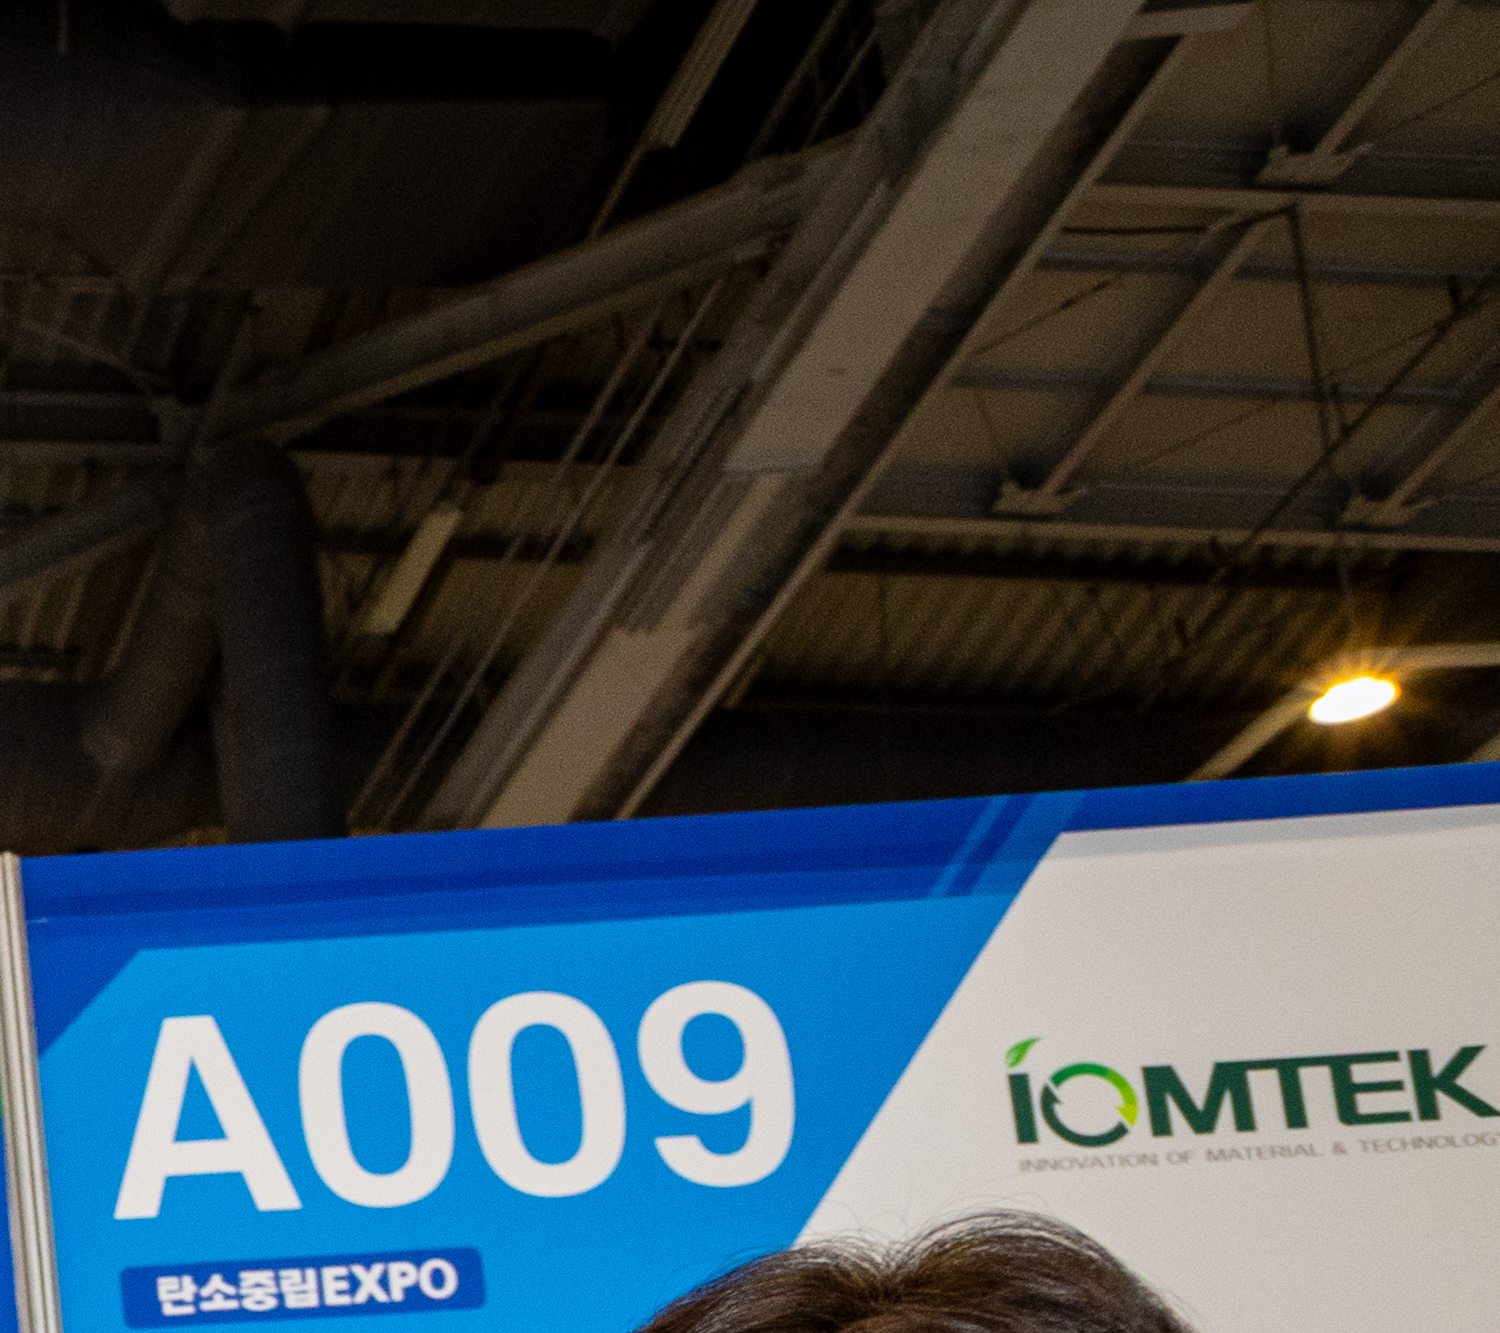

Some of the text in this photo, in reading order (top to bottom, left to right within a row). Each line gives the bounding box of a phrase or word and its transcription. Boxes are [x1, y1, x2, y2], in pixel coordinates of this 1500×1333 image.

[114, 979, 796, 1220] A009
[1205, 1141, 1319, 1163] MATERIAL
[157, 1257, 458, 1318] 탄소중립EXPO
